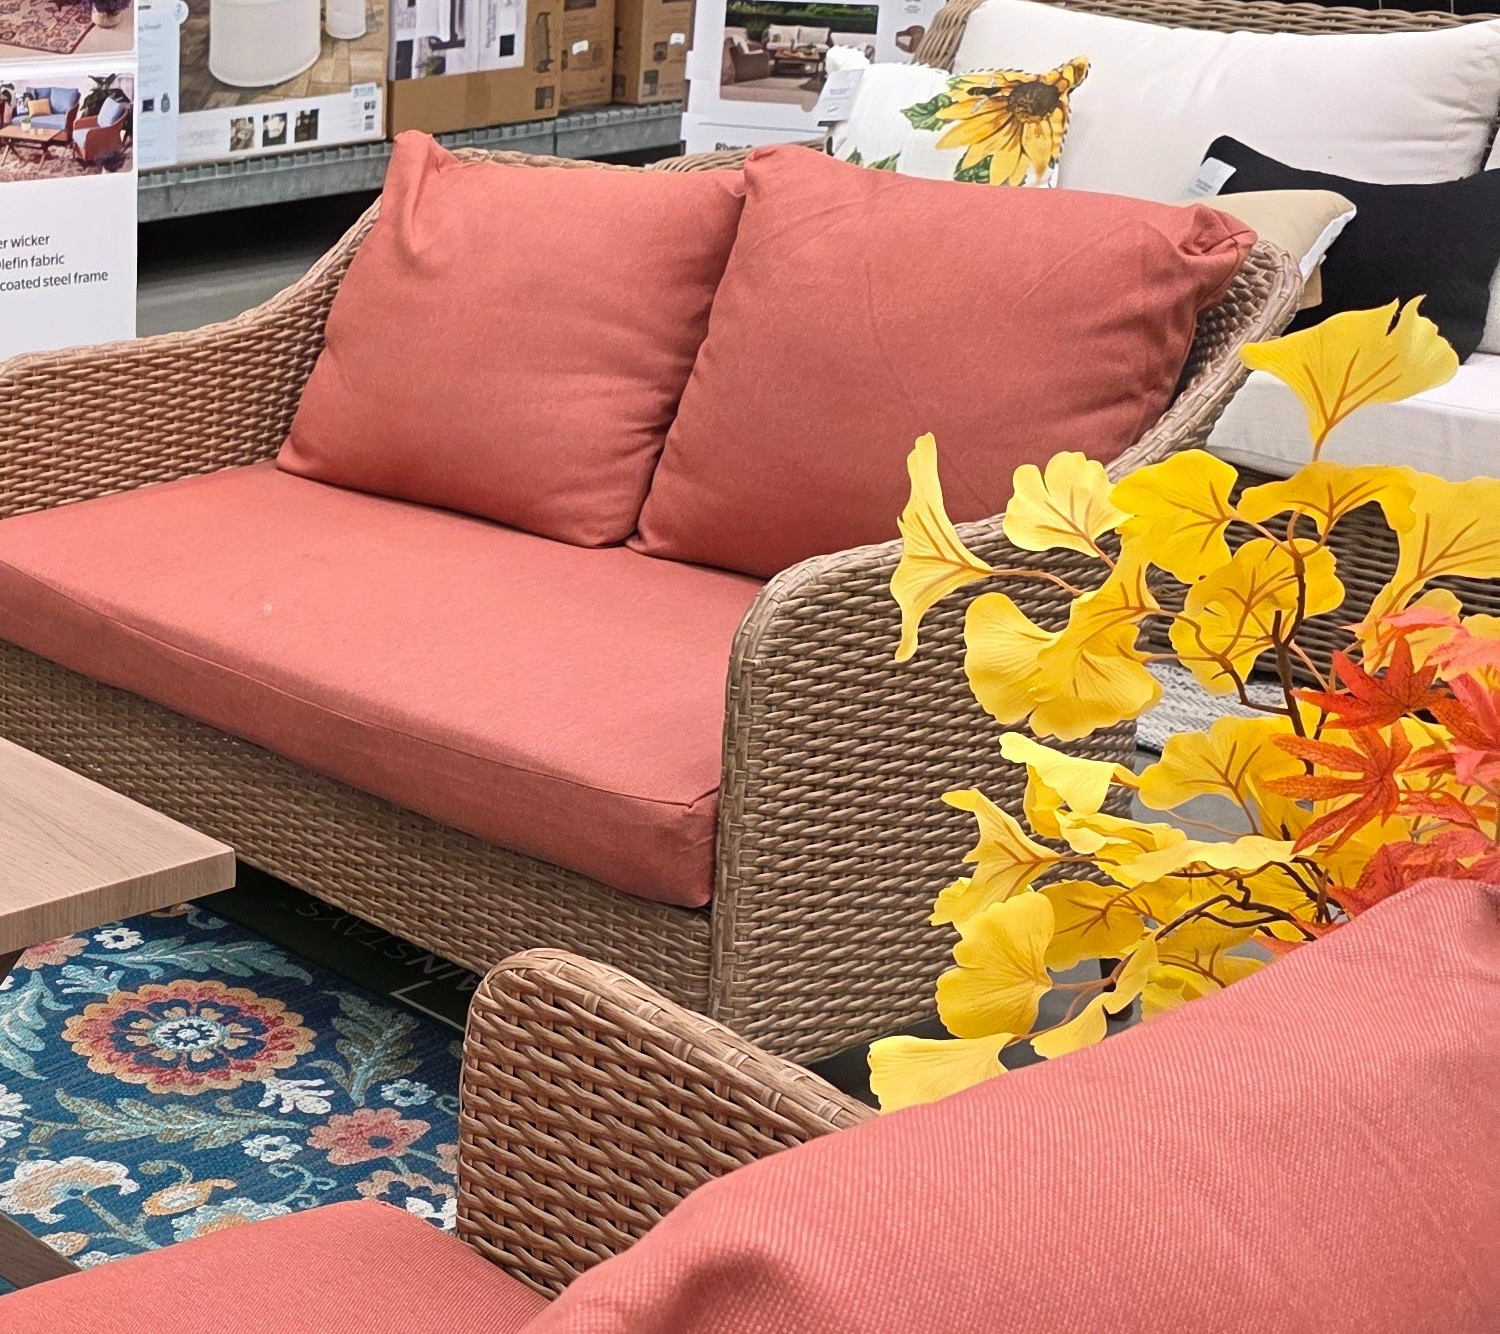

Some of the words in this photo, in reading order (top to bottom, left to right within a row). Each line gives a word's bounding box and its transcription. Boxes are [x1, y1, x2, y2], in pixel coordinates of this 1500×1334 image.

[10, 234, 50, 249] wicker
[30, 253, 66, 267] fabric
[43, 273, 71, 287] steel
[73, 270, 109, 285] frame
